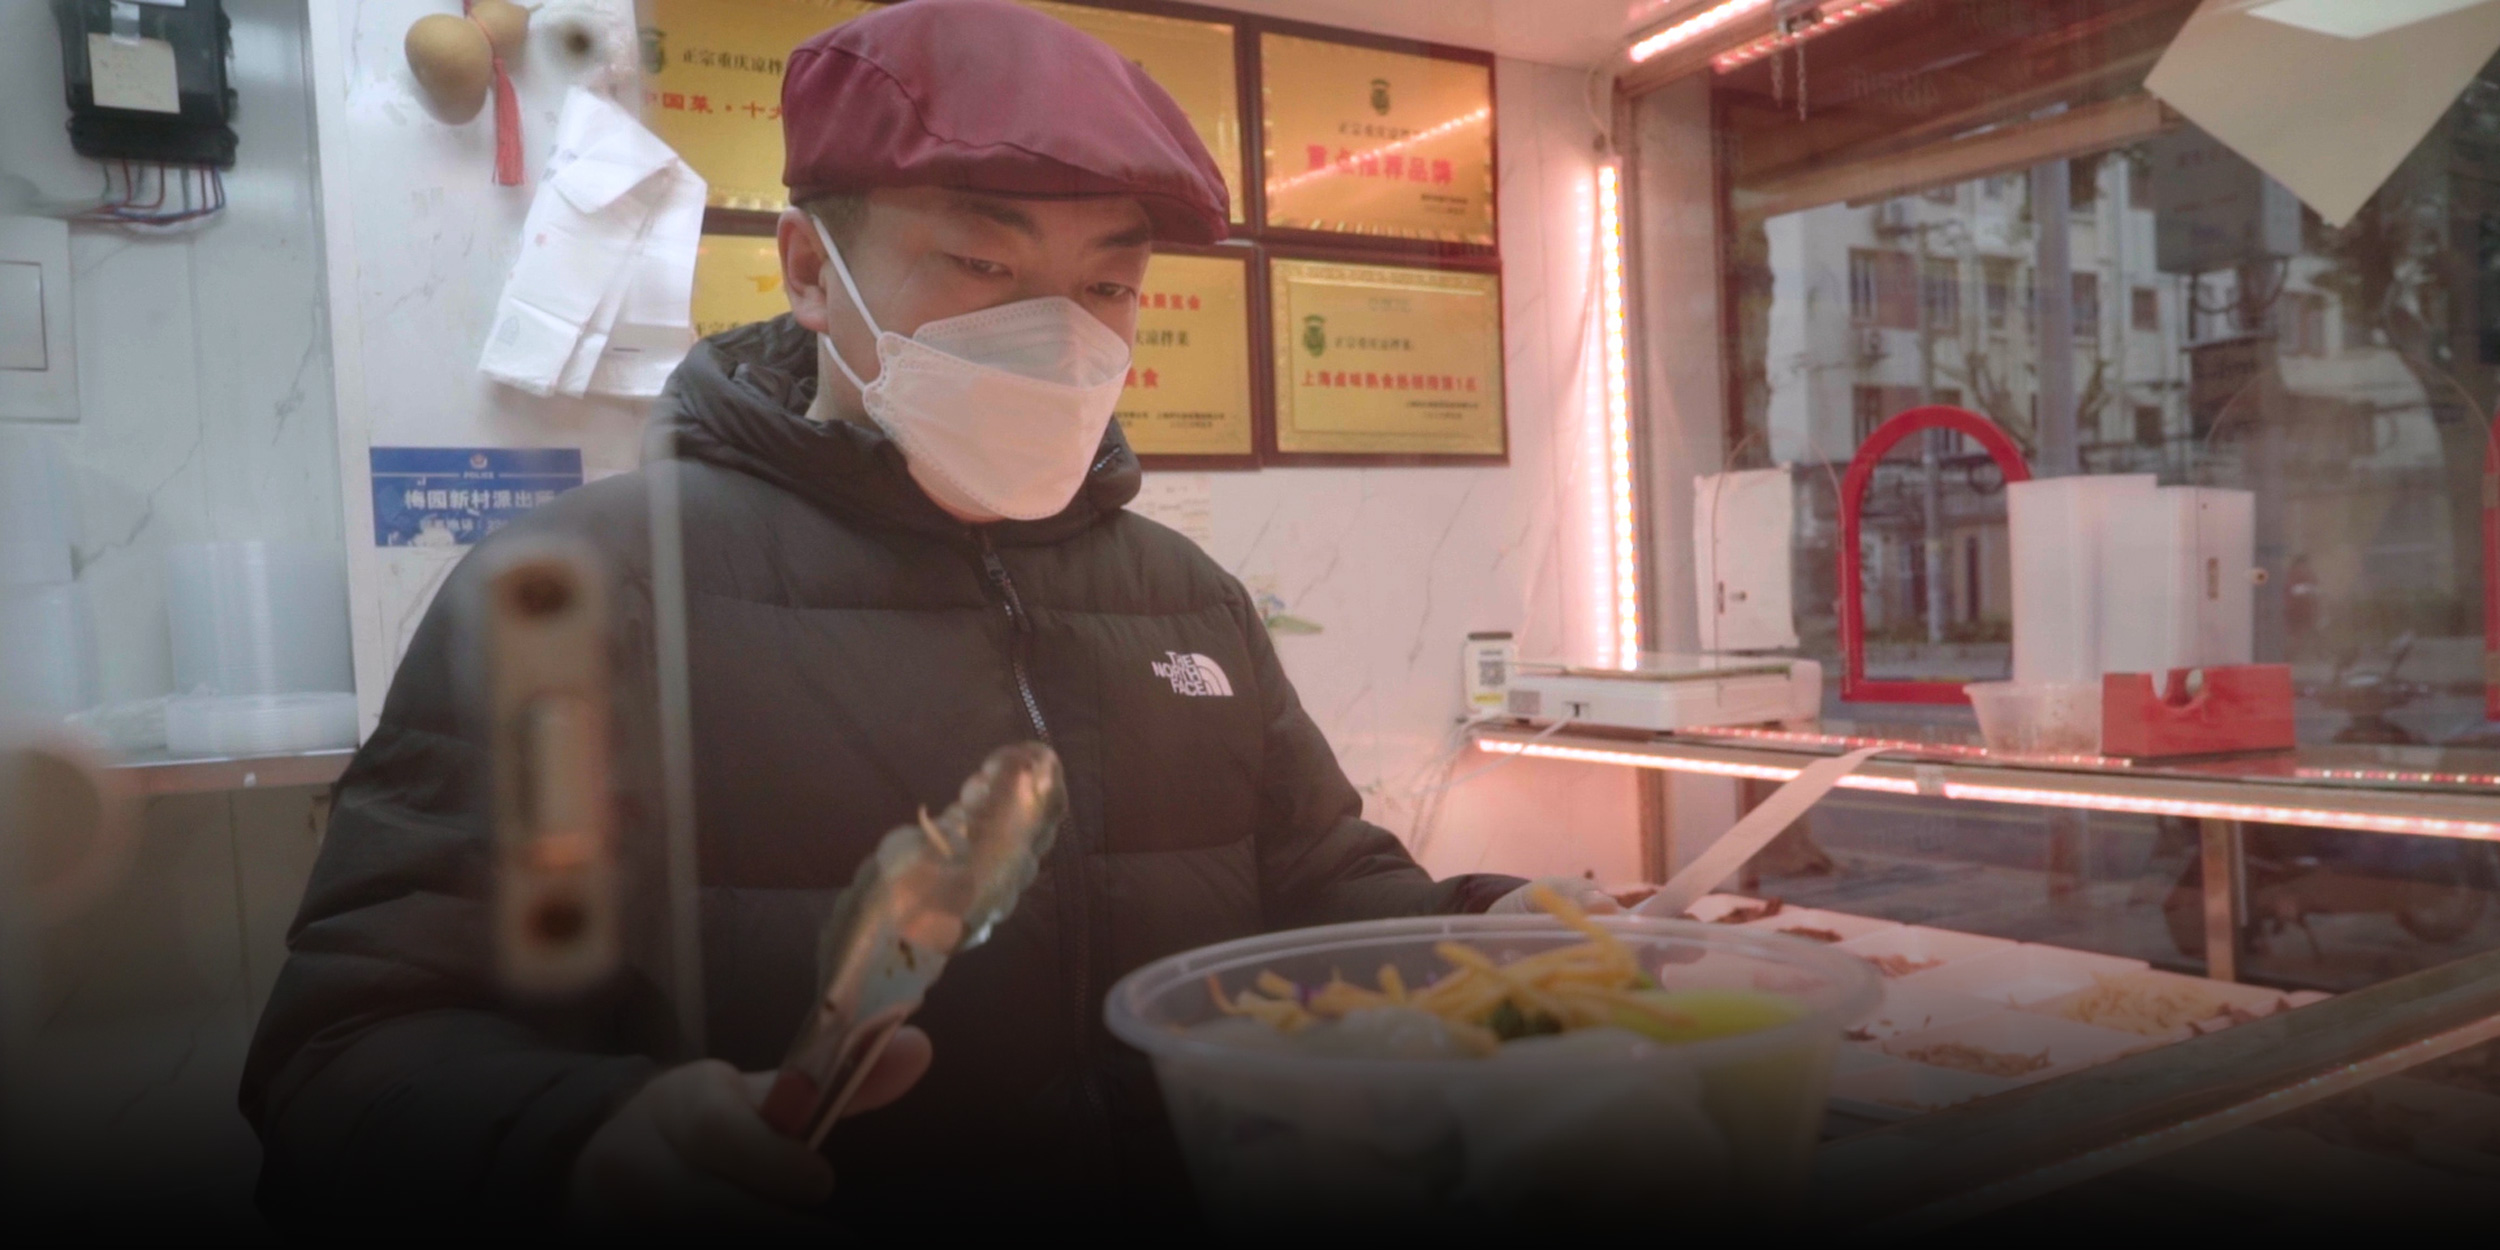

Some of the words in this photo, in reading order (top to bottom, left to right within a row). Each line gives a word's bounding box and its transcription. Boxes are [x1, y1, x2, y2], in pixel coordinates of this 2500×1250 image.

[1307, 144, 1453, 184] 重点推荐品牌
[463, 470, 495, 480] POLICE
[1165, 651, 1195, 668] THE
[1151, 660, 1201, 681] NORTH
[1170, 672, 1207, 696] FACE
